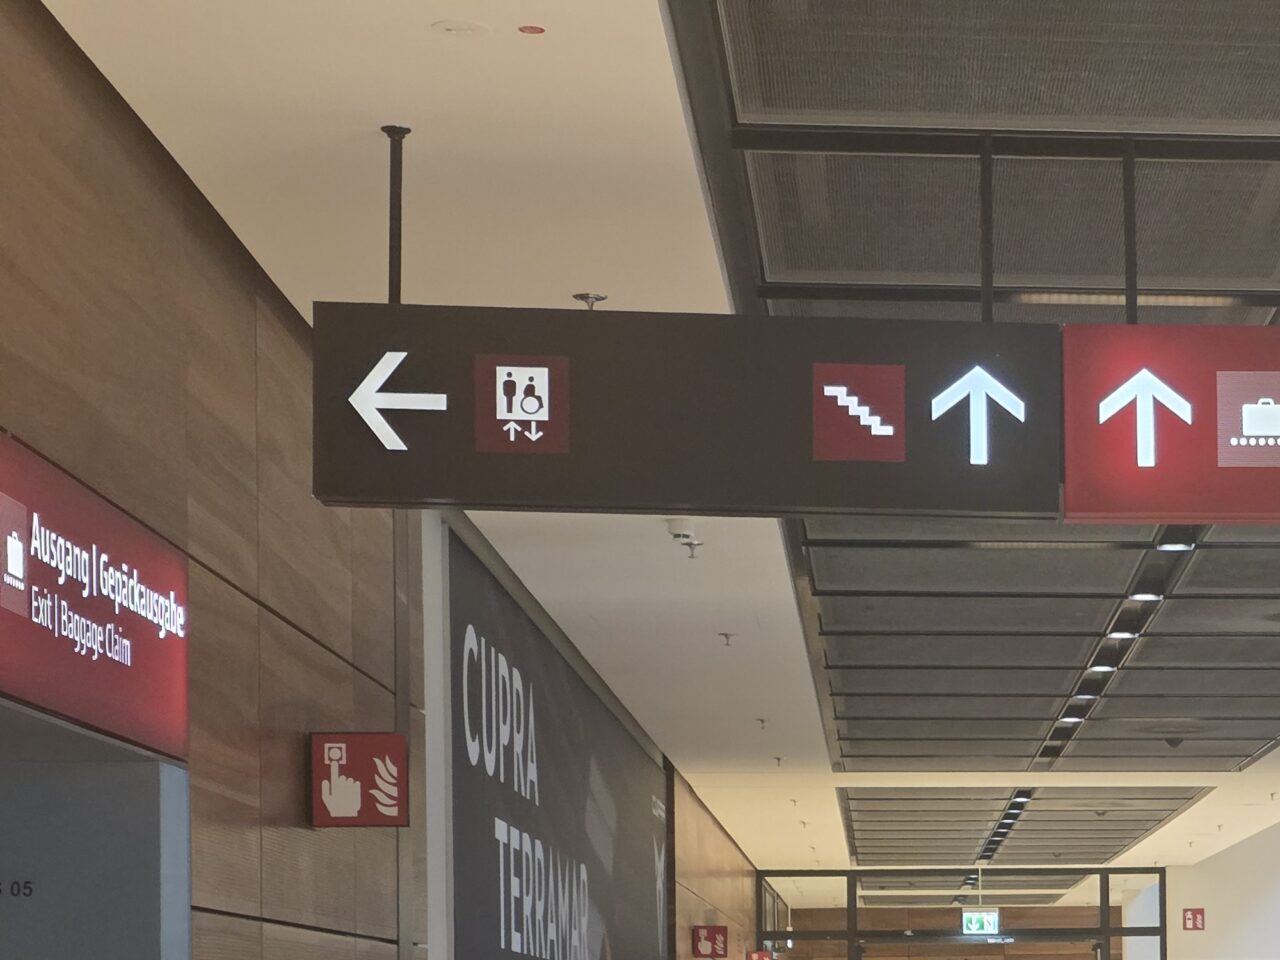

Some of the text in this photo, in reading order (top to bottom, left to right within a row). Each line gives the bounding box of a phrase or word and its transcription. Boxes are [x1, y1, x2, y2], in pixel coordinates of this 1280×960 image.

[30, 512, 89, 598] Ausgang
[100, 553, 186, 639] Gepäckausgabe
[31, 585, 52, 631] Exit
[61, 600, 104, 661] Baggage
[105, 623, 131, 667] Claim
[463, 624, 539, 806] CUPRA
[10, 880, 33, 897] 05
